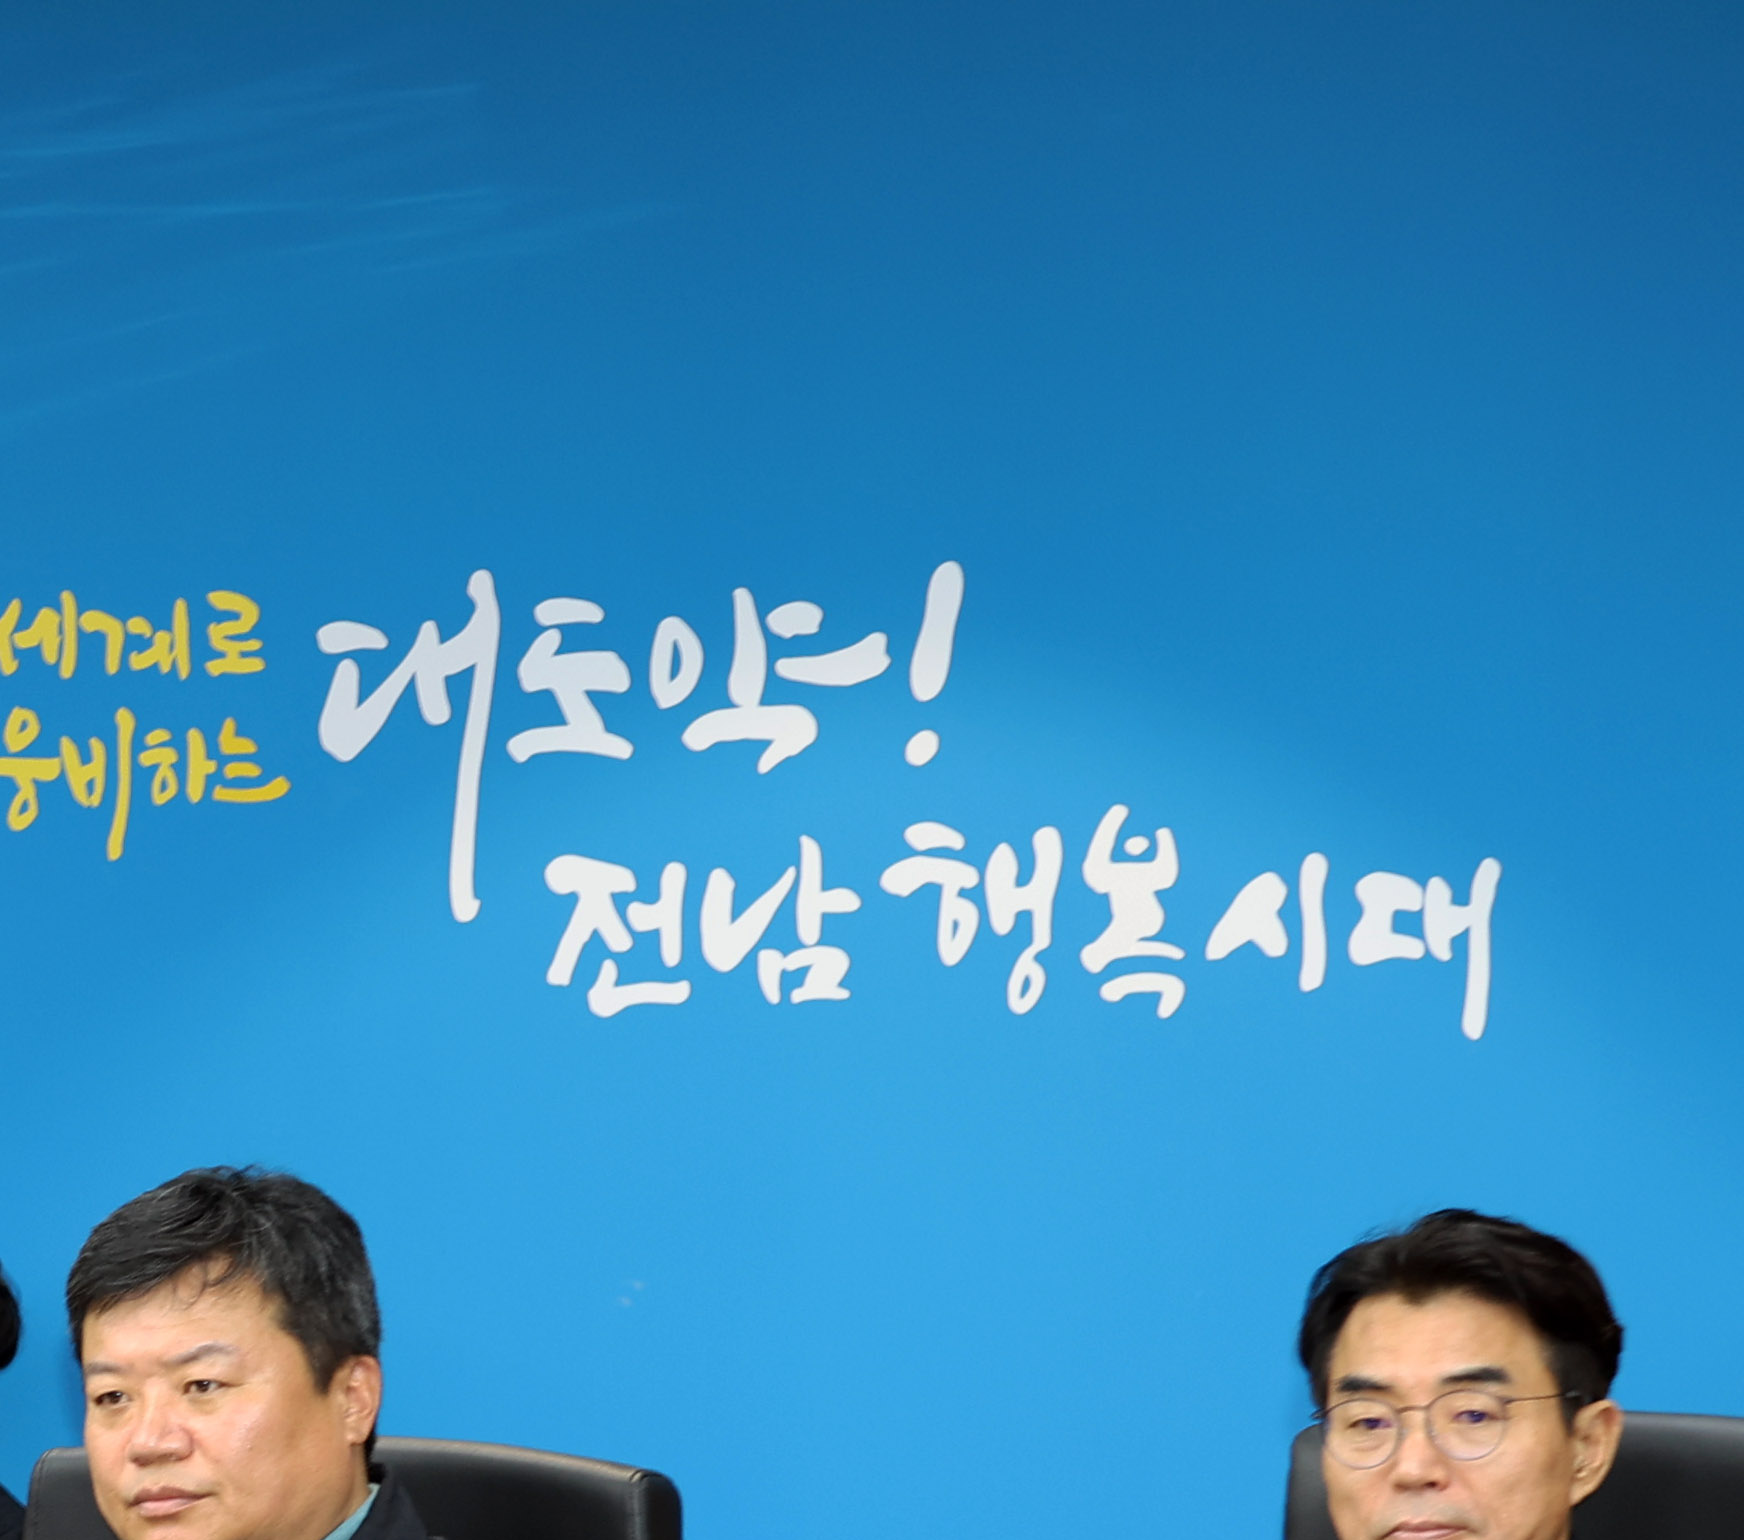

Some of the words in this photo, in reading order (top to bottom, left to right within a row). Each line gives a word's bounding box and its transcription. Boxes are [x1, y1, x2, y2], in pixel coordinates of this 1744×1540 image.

[316, 560, 965, 924] 대도약!
[542, 836, 862, 1018] 전남
[880, 804, 1186, 1018] 행복
[1206, 850, 1502, 1040] 시대
